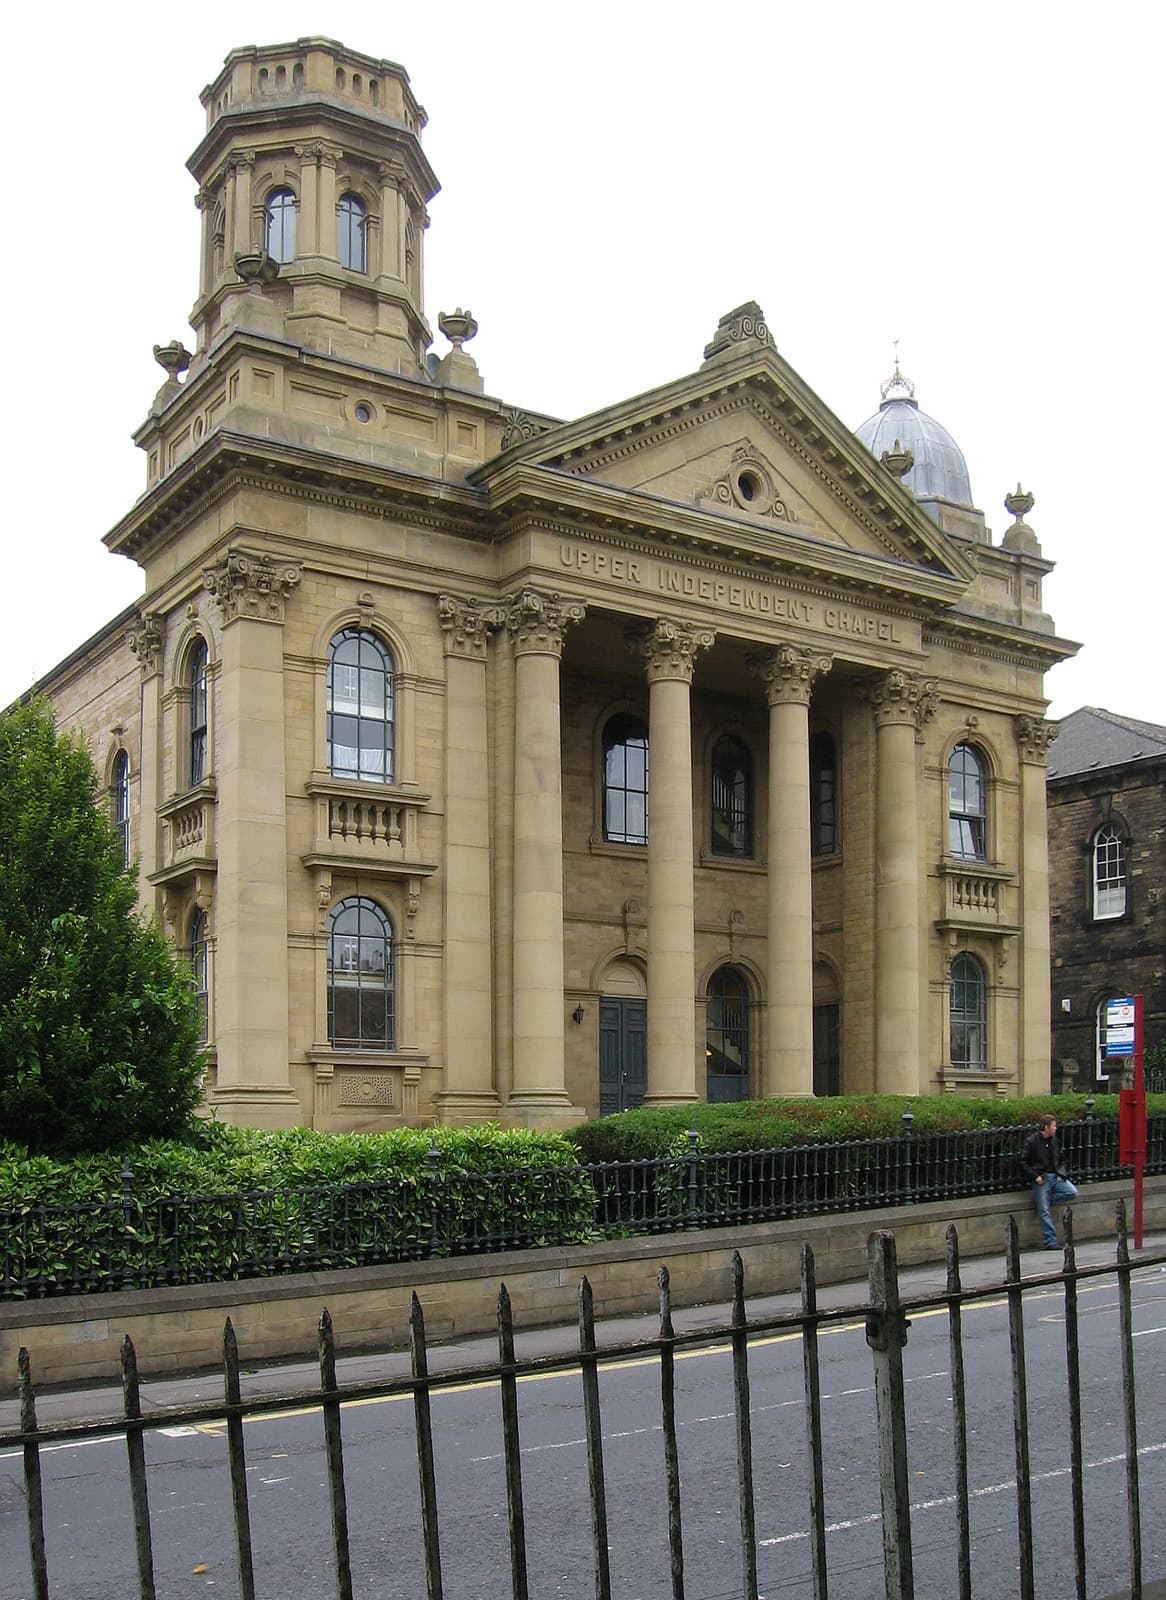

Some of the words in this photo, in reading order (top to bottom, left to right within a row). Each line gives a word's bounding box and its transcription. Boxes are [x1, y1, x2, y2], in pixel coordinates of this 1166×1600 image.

[559, 545, 641, 583] UPPER
[658, 567, 814, 623] INDEPENDENT
[824, 607, 902, 643] CHAPEL
